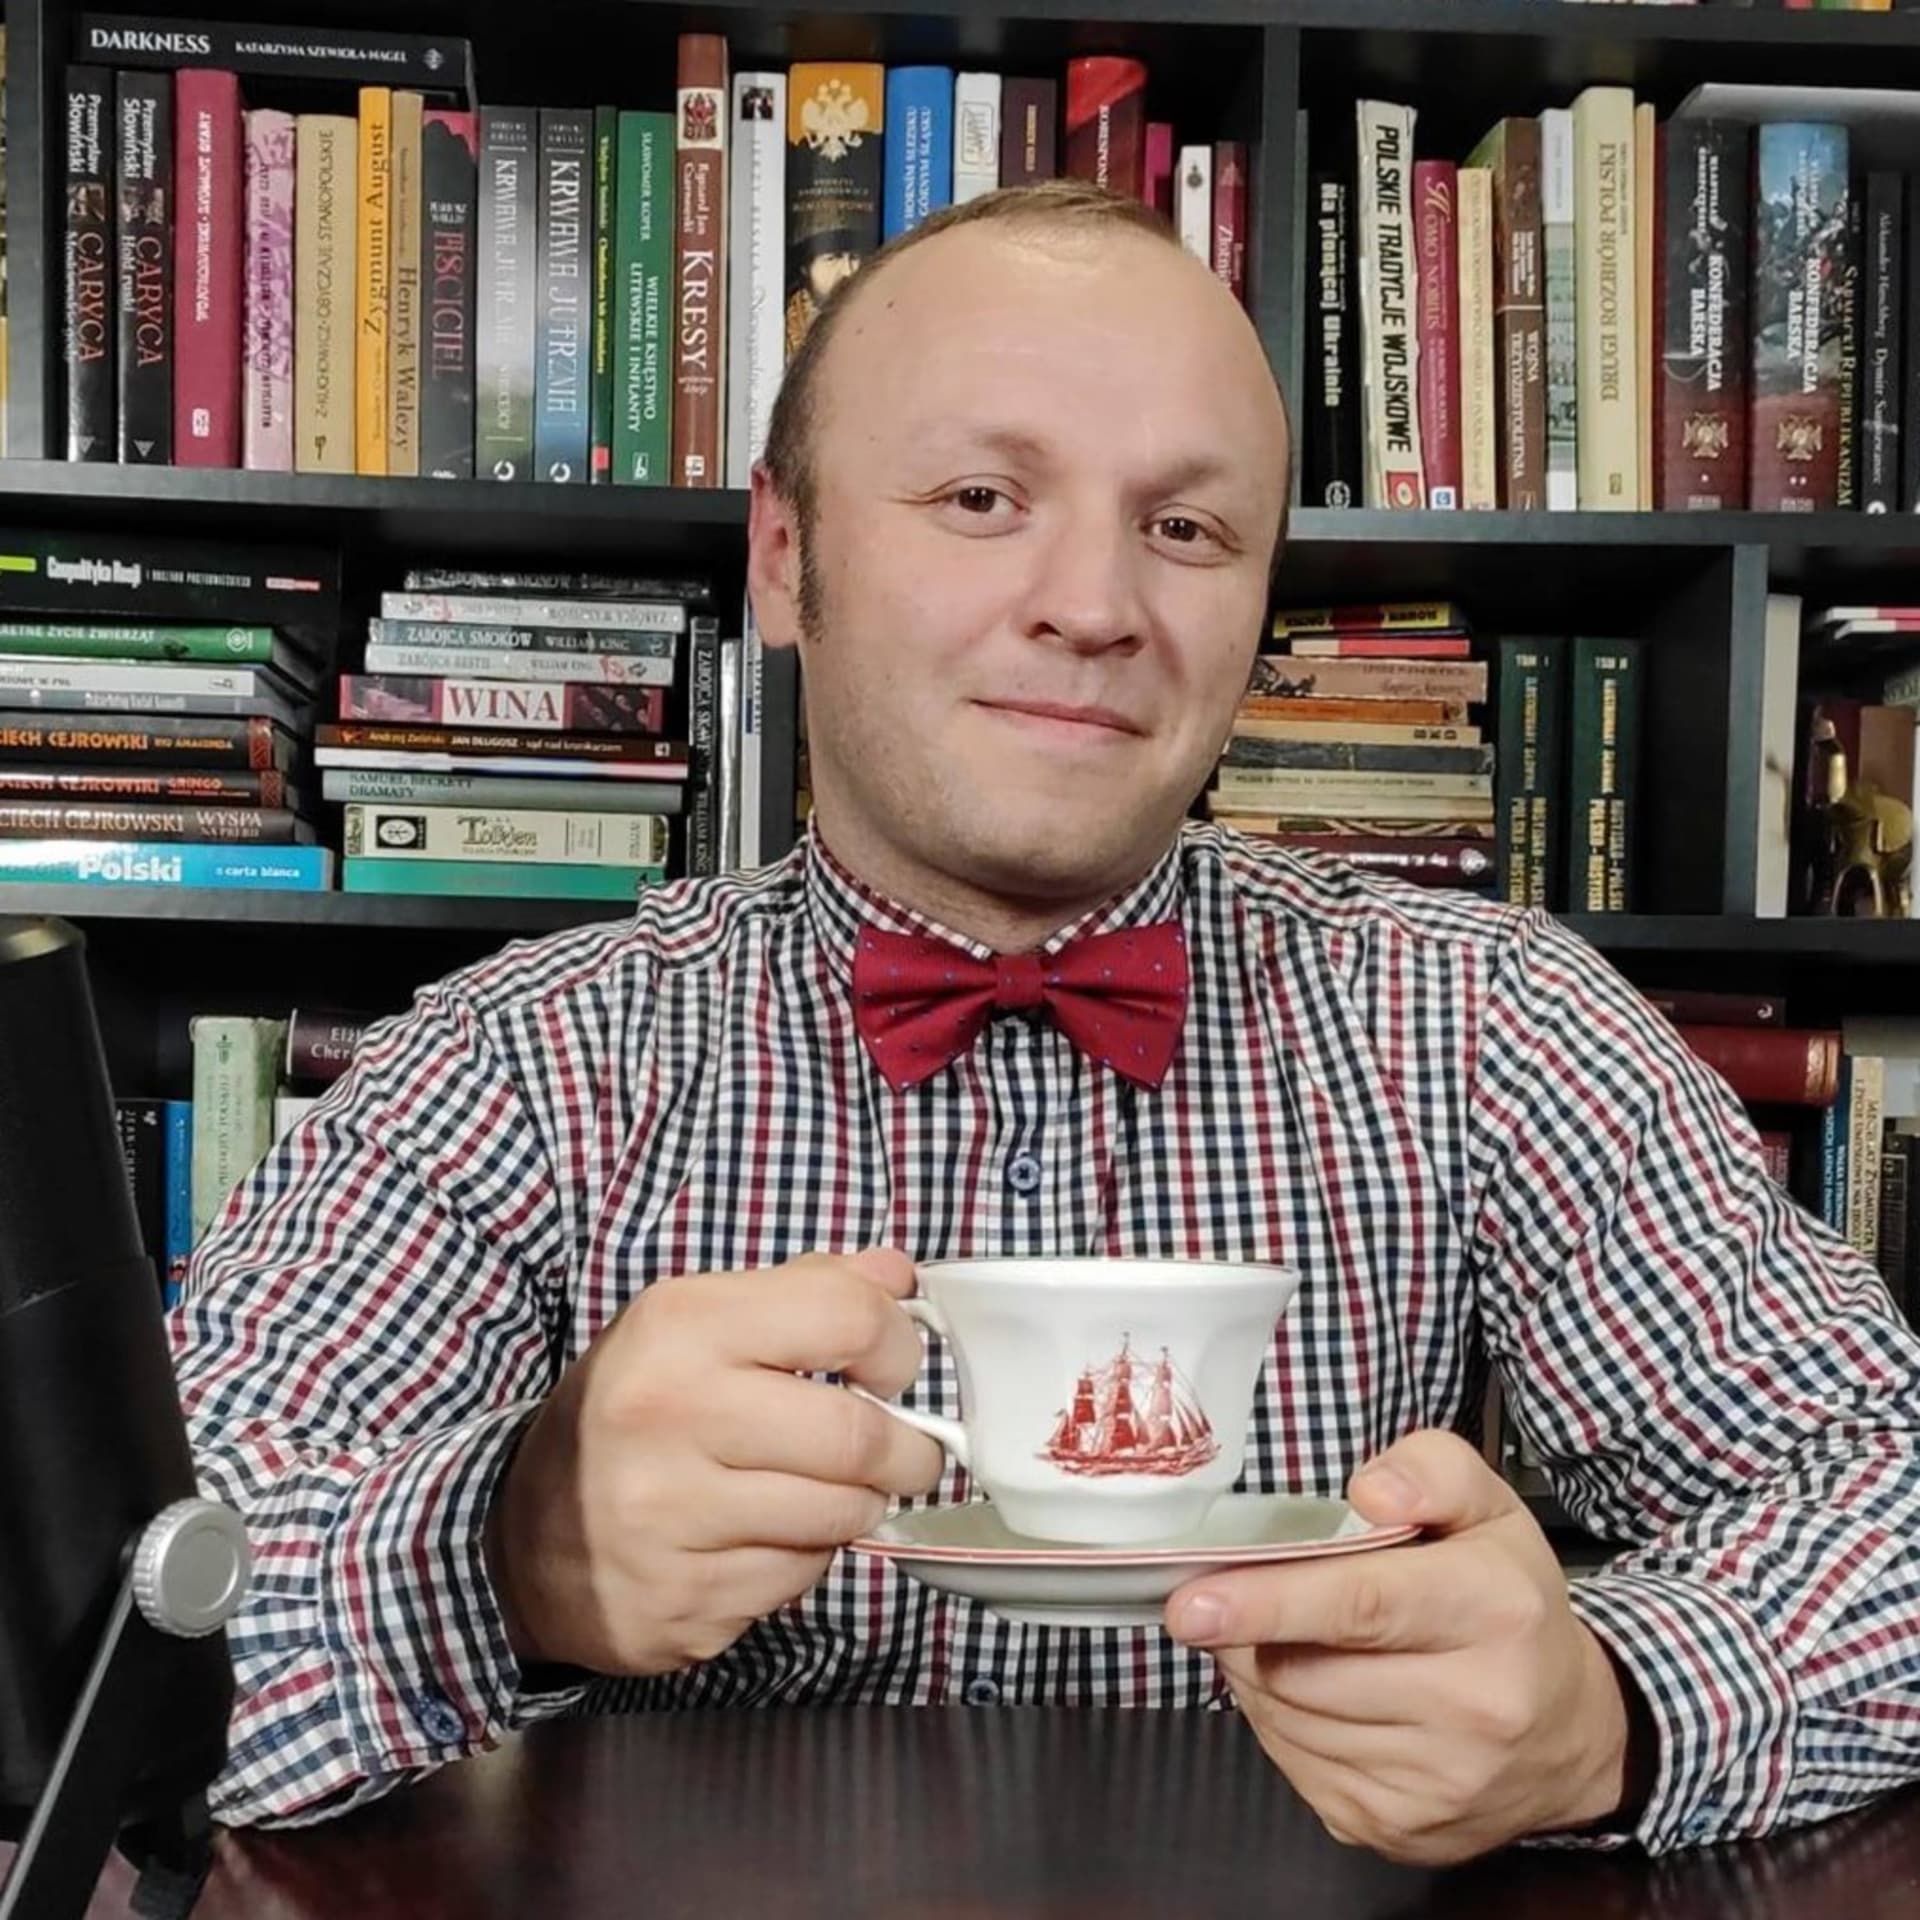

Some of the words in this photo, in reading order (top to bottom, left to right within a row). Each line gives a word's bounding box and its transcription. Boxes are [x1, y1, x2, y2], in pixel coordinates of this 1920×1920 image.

[91, 28, 211, 54] DARKNESS
[235, 41, 305, 58] KATARZYNA
[68, 94, 85, 174] Słowiński
[84, 95, 101, 175] Przemysław
[123, 99, 140, 179] Słowiński
[139, 99, 157, 180] Przemysław
[364, 123, 389, 209] August
[1375, 125, 1401, 214] POLSKIE
[317, 129, 333, 241] STAROPOLSKIE
[548, 159, 582, 277] KRWAWA
[639, 201, 653, 240] KOPER
[1321, 183, 1338, 213] Na
[1597, 142, 1618, 224] POLSKI
[78, 232, 104, 363] CARYCA
[136, 236, 164, 368] CARYCA
[363, 218, 390, 336] Zygmunt
[629, 262, 643, 341] LITEWSKIE
[1318, 219, 1340, 308] płonącej
[1378, 223, 1406, 327] TRADYCJE
[1426, 265, 1440, 330] NOBILIS
[1597, 231, 1619, 325] ROZBIÓR
[395, 266, 417, 357] Henryk
[644, 276, 659, 338] WIELKIE
[681, 249, 714, 371] KRESY
[1690, 288, 1705, 356] BARSKA
[1706, 255, 1723, 391] KONFEDERACJA
[1787, 291, 1803, 359] BARSKA
[1803, 258, 1821, 392] KONFEDERACJA
[627, 356, 642, 432] INFLANTY
[642, 342, 658, 419] KSIĘSTWO
[1323, 315, 1342, 407] Ukrainie
[1381, 333, 1412, 454] WOJSKOWE
[1600, 333, 1620, 402] DRUGI
[1871, 348, 1888, 396] Dymitr
[393, 366, 415, 452] Walezy
[47, 625, 85, 639] ŻYCIE
[408, 630, 463, 646] ZABÓJCA
[469, 630, 532, 648] SMOKÓW
[449, 686, 560, 721] WINA
[694, 650, 712, 706] ZABÓJCA
[48, 731, 148, 750] CEJROWSKI
[349, 773, 406, 785] SAMUEL
[369, 732, 405, 746] Andrzej
[450, 736, 470, 746] JAN
[472, 736, 519, 748] DŁUGOSZ
[545, 738, 561, 749] nad
[57, 776, 160, 794] CEJROWSKI
[168, 777, 222, 790] GRINGO
[65, 810, 184, 834] CEJROWSKI
[195, 810, 262, 828] WYSPA
[349, 785, 416, 799] DRAMATY
[78, 856, 181, 882] Polski
[225, 866, 256, 878] carta
[260, 865, 300, 879] blanca
